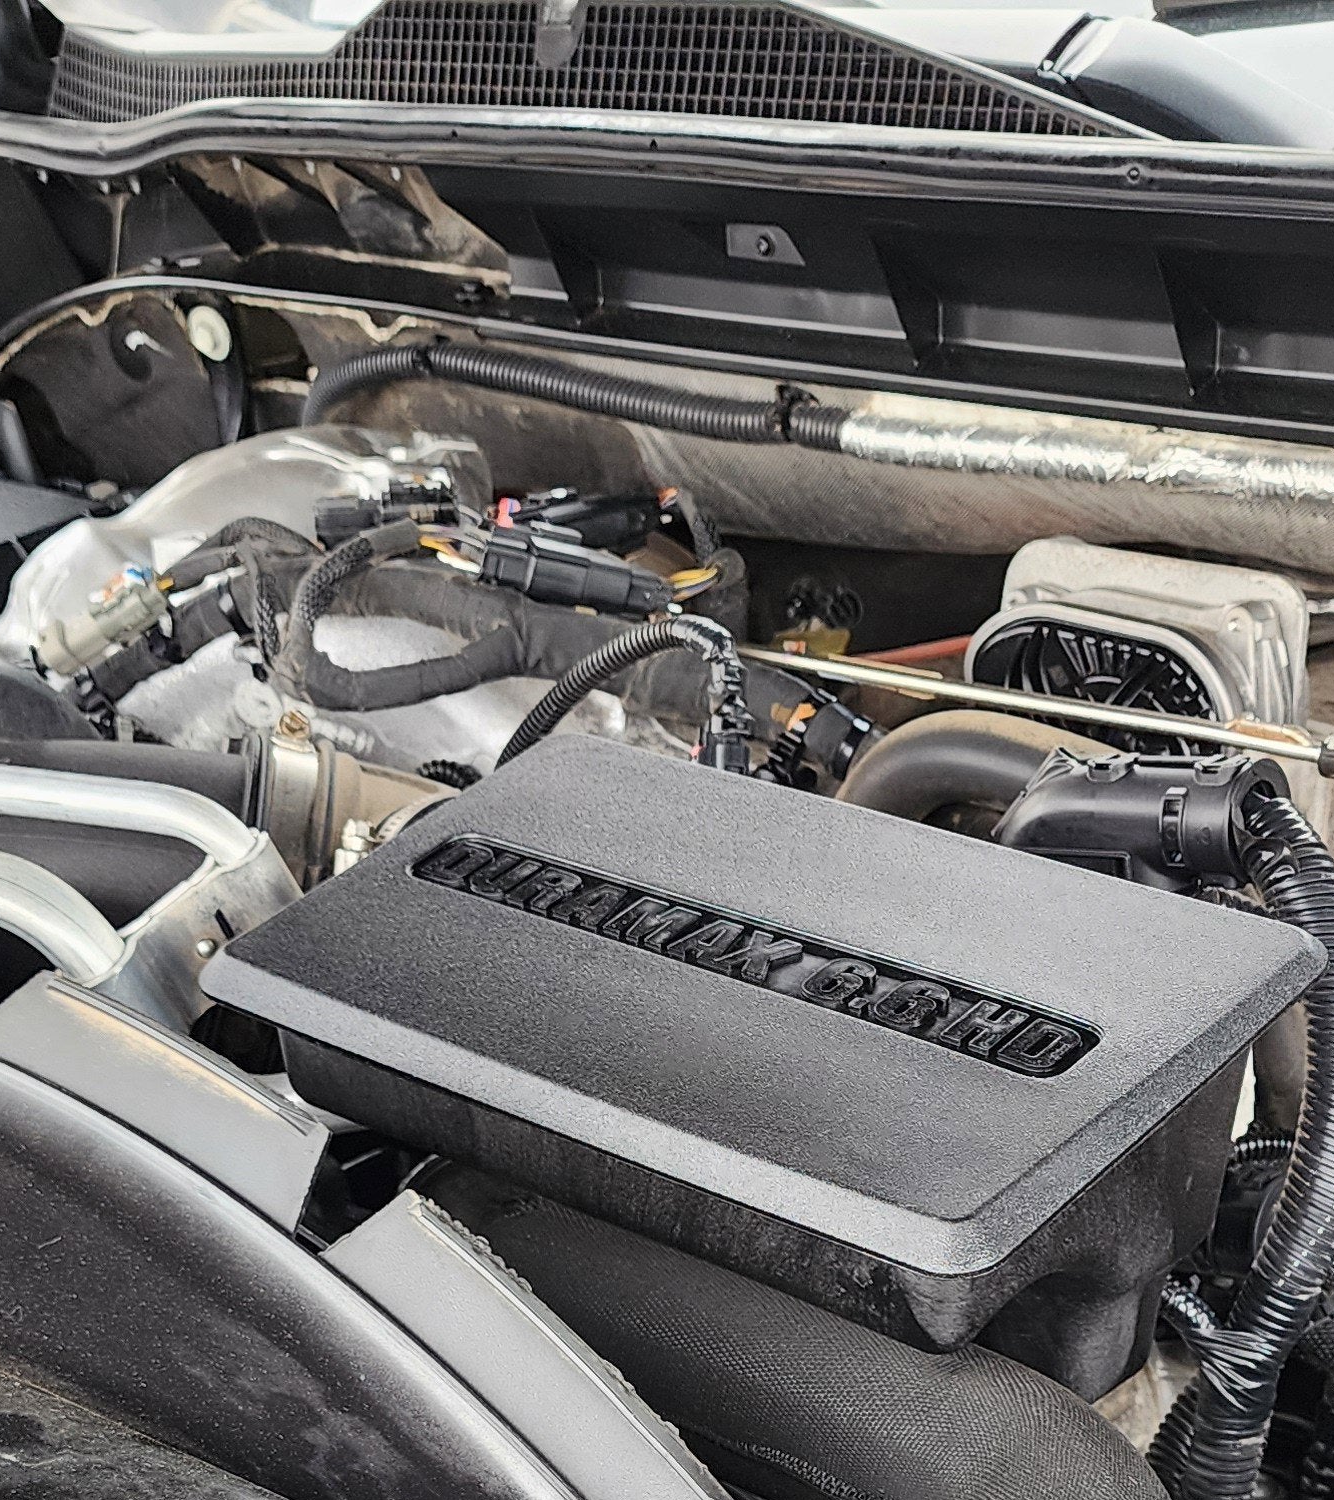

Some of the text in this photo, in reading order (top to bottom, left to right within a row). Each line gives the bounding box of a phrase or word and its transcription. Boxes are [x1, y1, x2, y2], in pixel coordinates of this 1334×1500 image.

[417, 842, 1083, 1073] DURAMAX 6.6 HD
